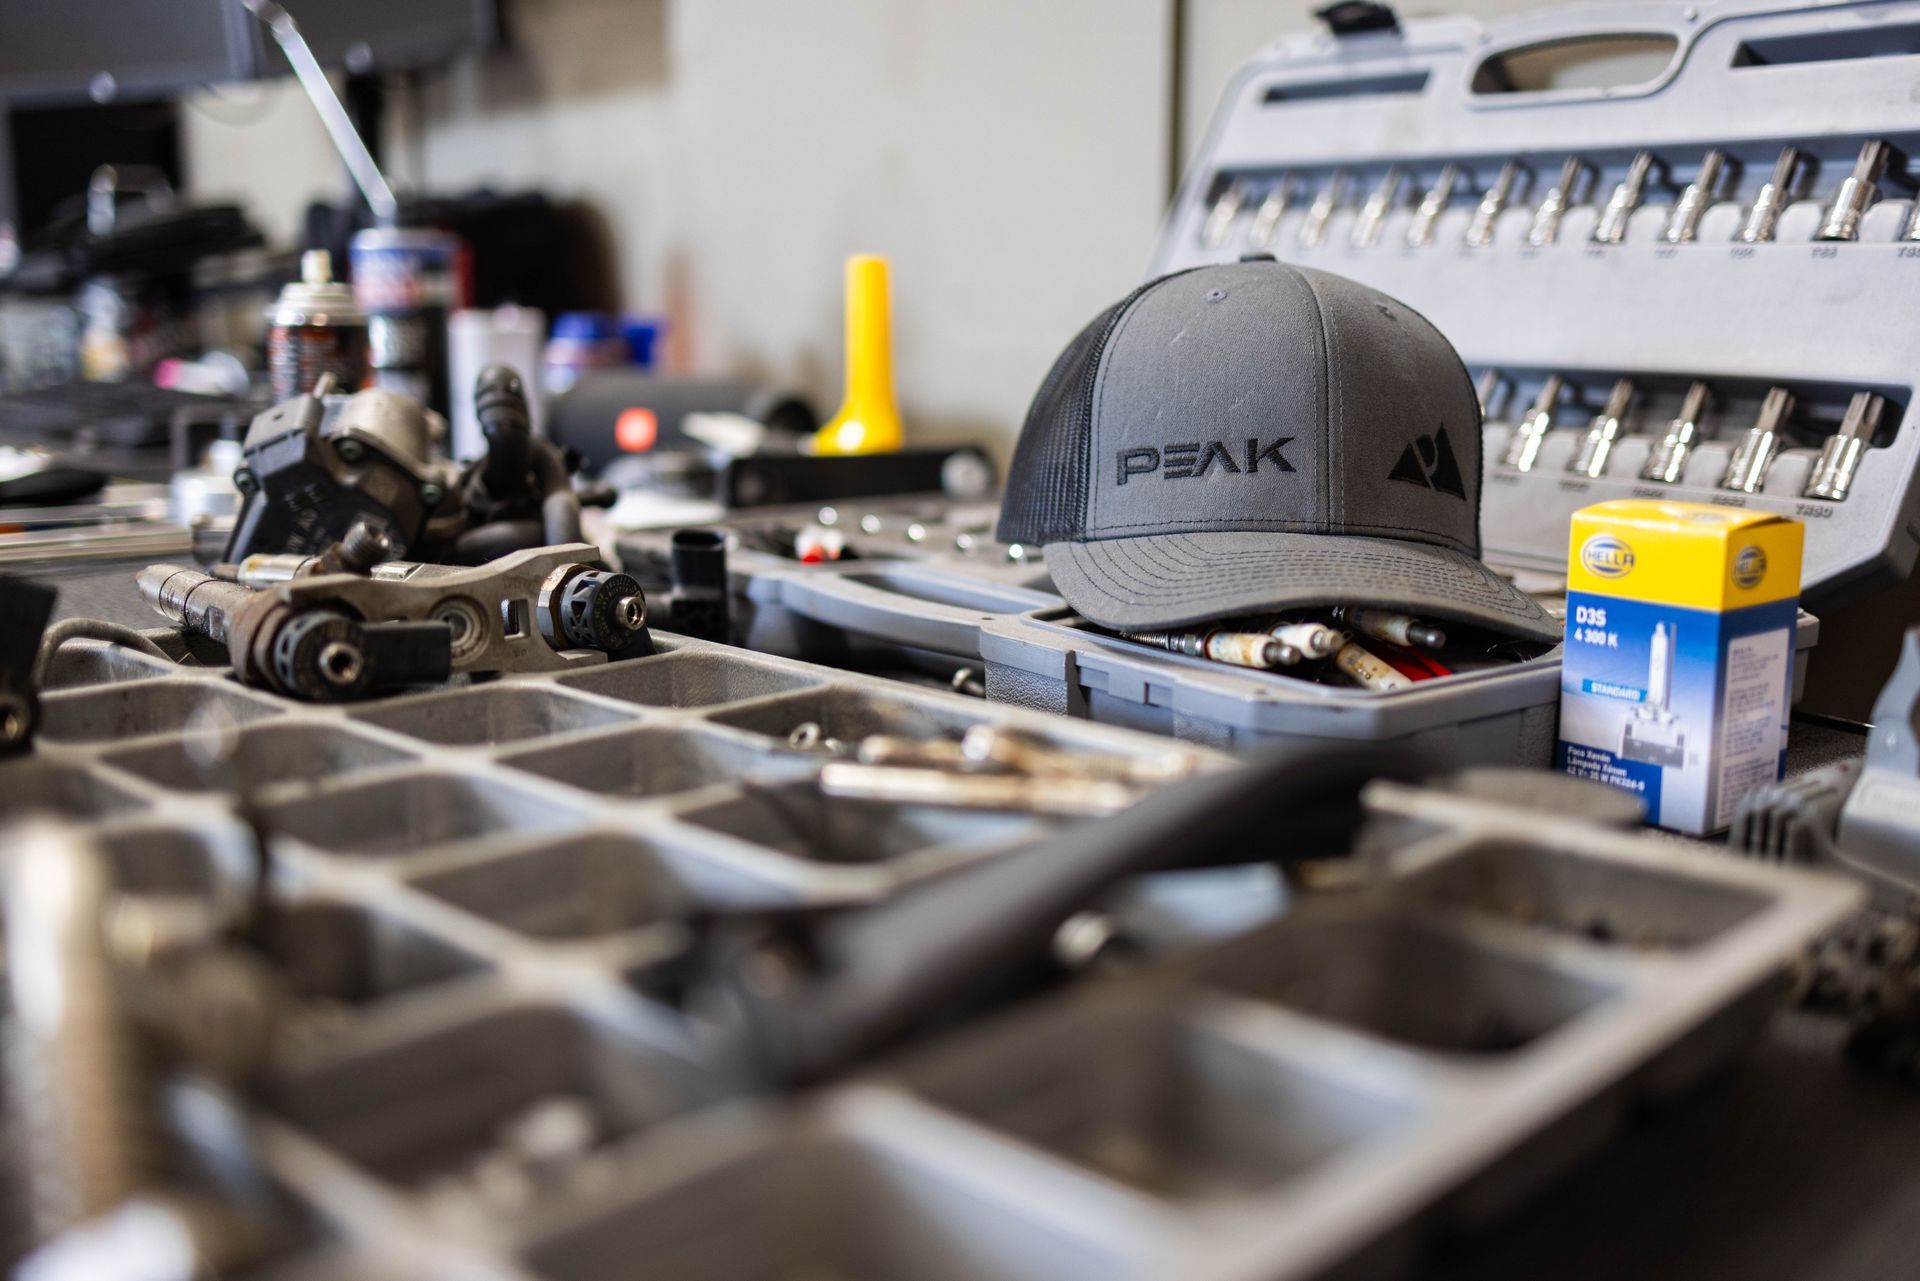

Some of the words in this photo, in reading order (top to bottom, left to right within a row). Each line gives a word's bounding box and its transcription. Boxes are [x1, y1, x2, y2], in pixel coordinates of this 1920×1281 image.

[1116, 436, 1298, 486] PEAK
[1587, 550, 1635, 568] HELLA
[1576, 606, 1607, 628] D3S
[1574, 627, 1583, 641] 4
[1584, 628, 1607, 646] 300
[1607, 631, 1618, 648] K
[1591, 682, 1641, 700] STANDARD
